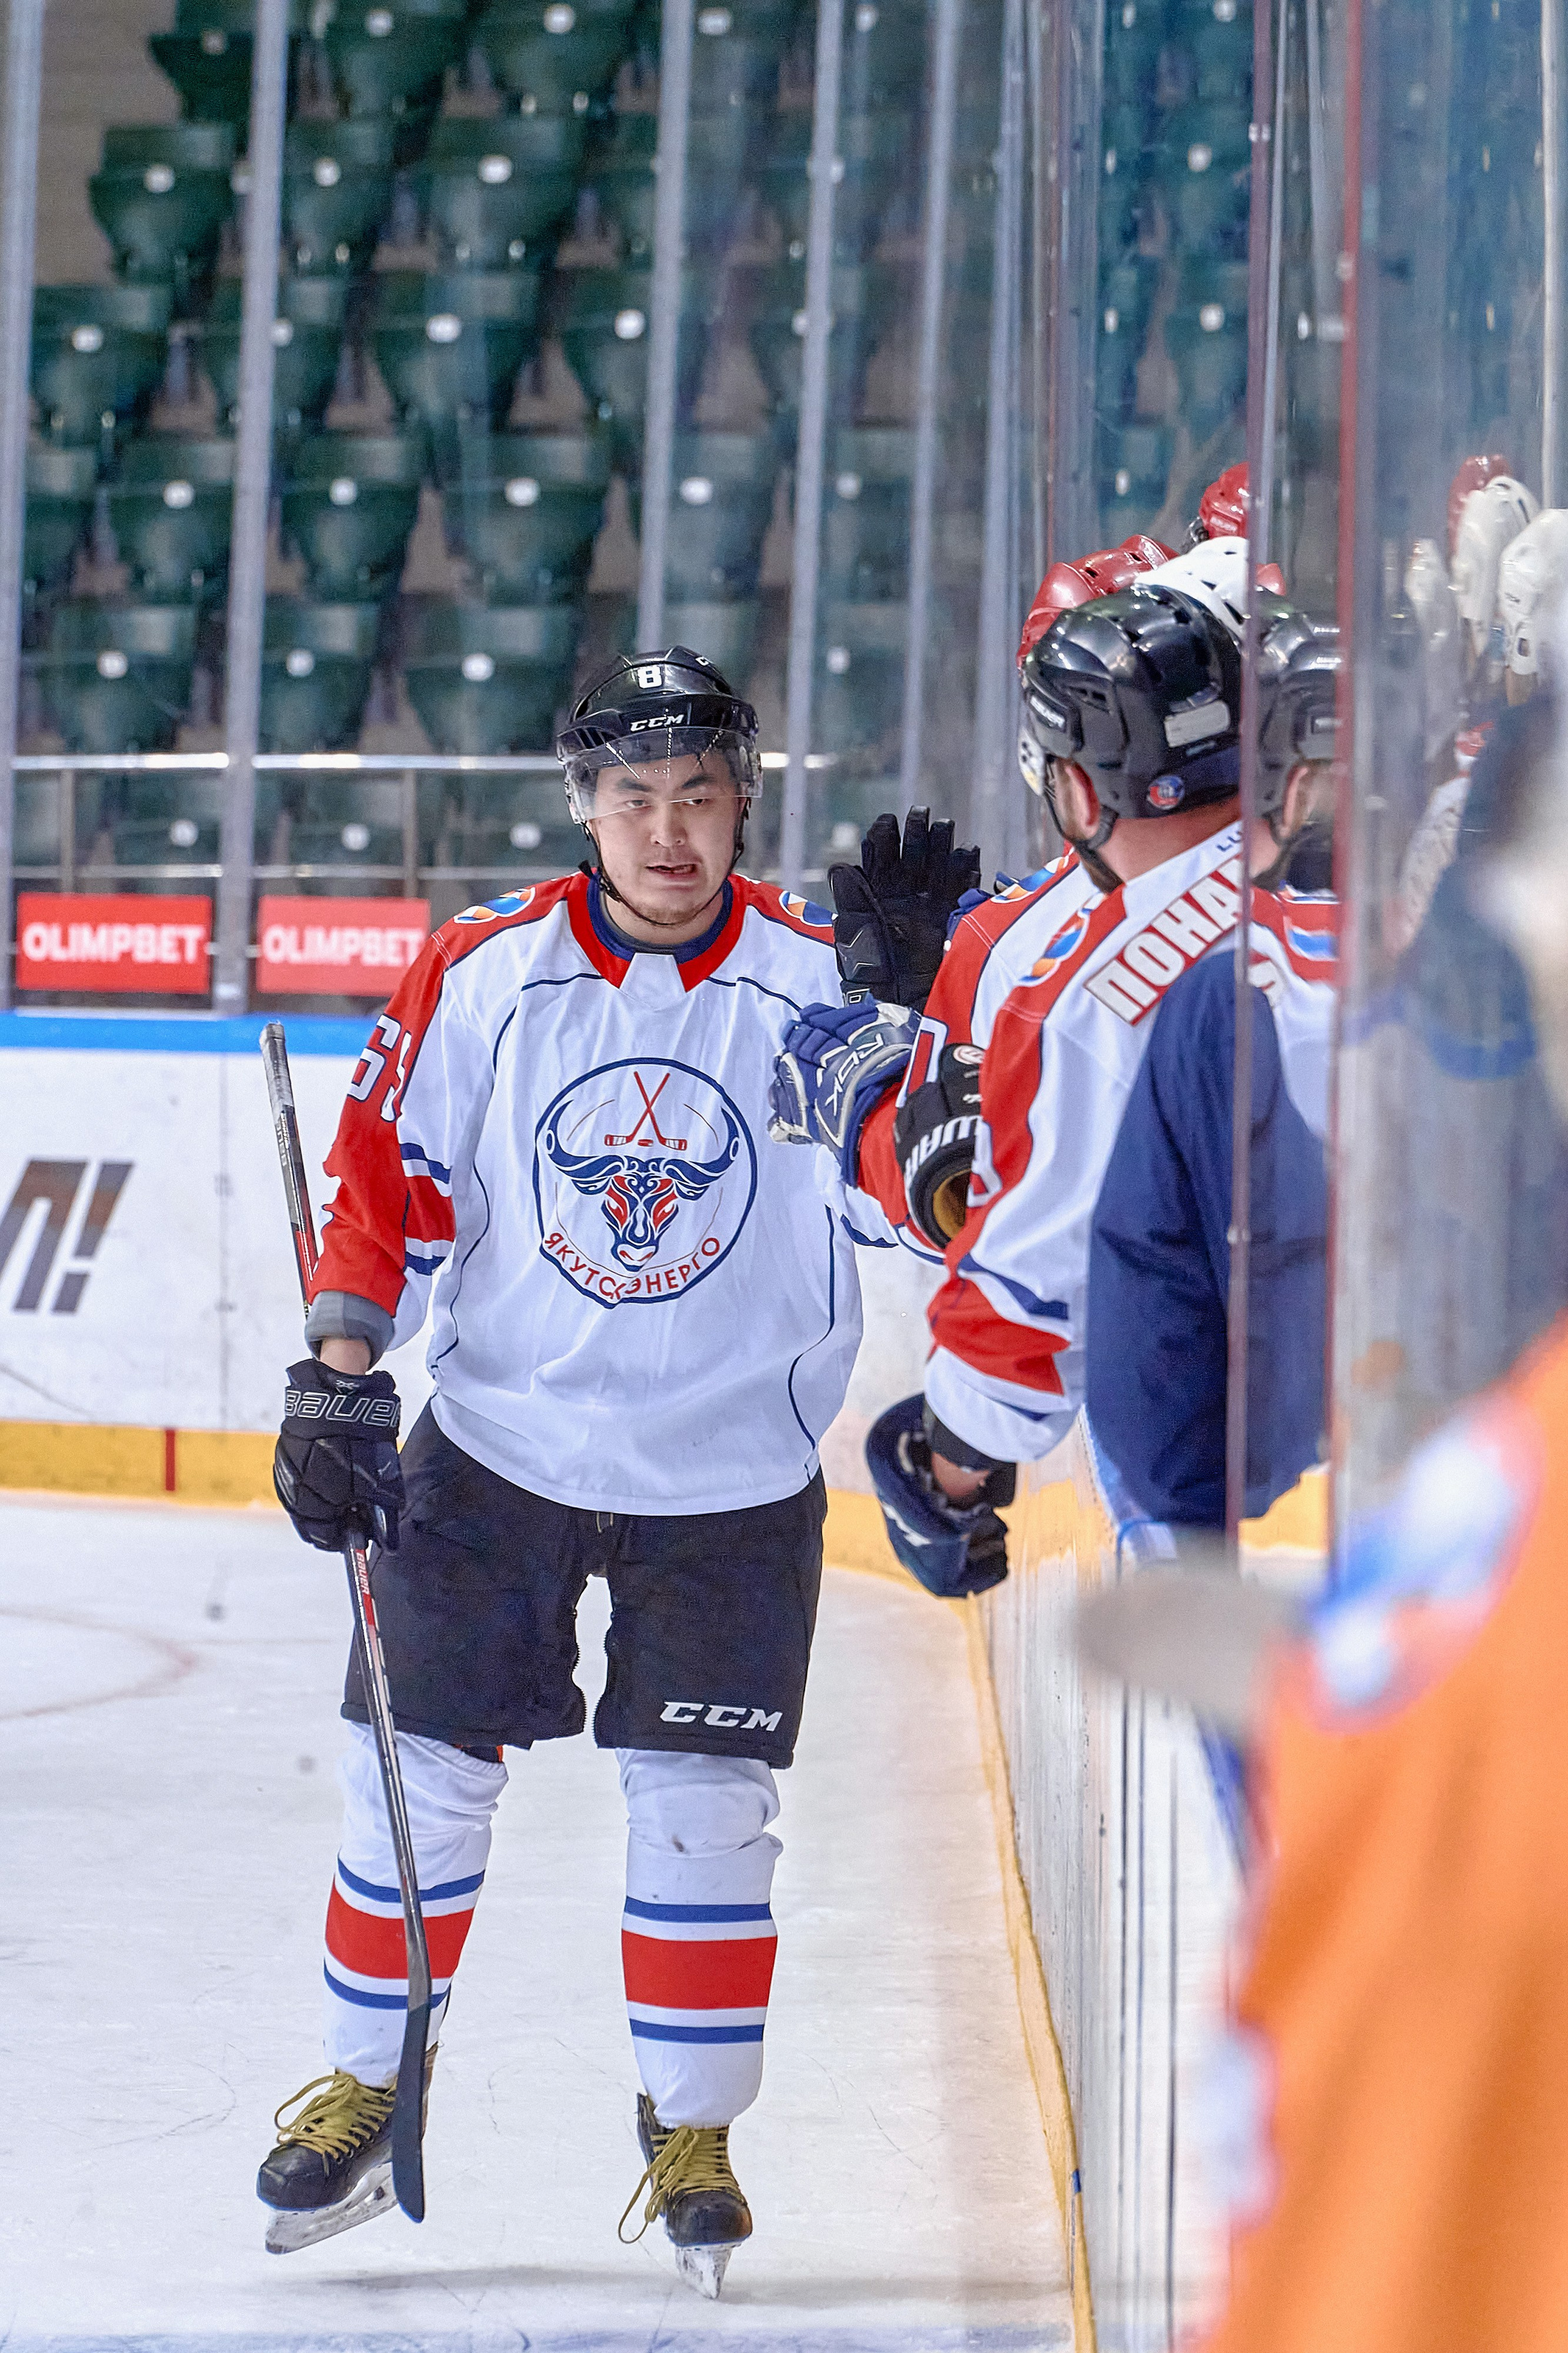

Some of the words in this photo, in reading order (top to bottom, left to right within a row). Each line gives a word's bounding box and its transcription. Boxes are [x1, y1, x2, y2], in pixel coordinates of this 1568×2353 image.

[637, 666, 662, 689] 8
[630, 713, 685, 732] CCM
[22, 922, 205, 963] OLIMPBET
[262, 925, 426, 967] OLIMPBET
[356, 1551, 369, 1595] BAUER
[660, 1701, 783, 1732] CCM
